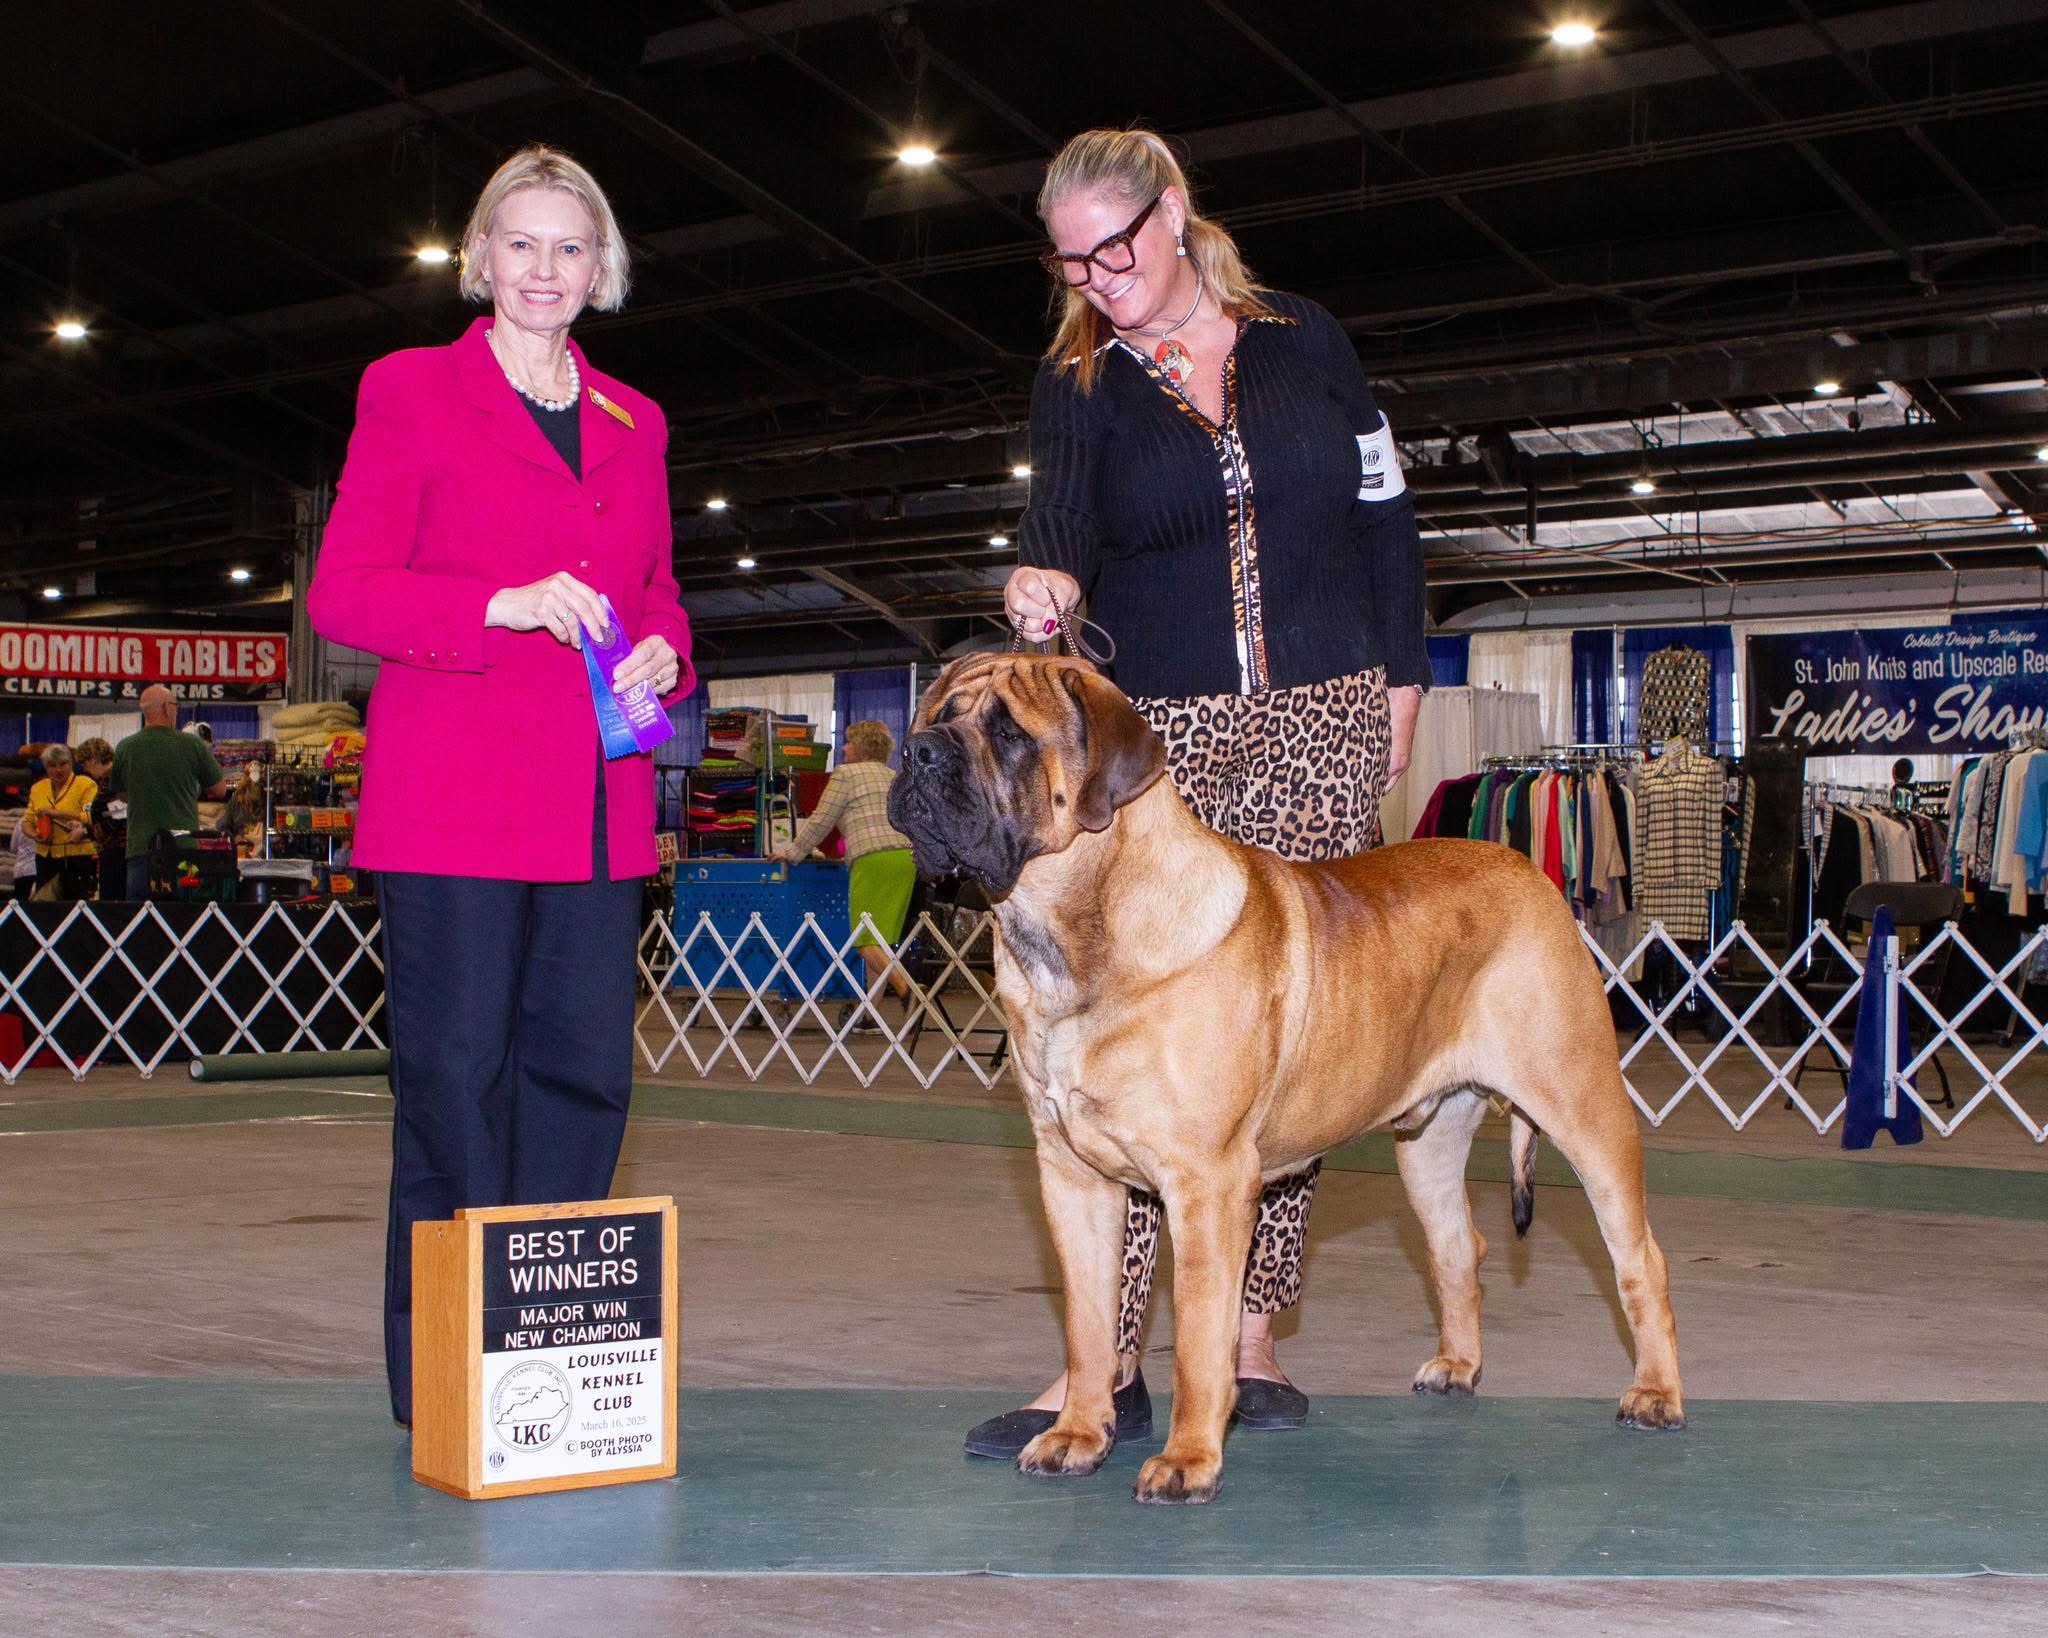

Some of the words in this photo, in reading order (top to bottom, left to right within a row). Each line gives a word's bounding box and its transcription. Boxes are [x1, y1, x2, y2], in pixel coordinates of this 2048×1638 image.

[1903, 632, 1944, 648] Cobalt
[1945, 631, 1985, 649] Design
[1987, 629, 2038, 647] Boutique
[0, 632, 143, 676] OOMING
[156, 638, 276, 678] TABLES
[1795, 658, 1818, 685] St.
[1825, 656, 1860, 683] John
[1867, 653, 1906, 681] Knits
[1913, 652, 1944, 680] and
[1951, 650, 2017, 683] Upscale
[5, 677, 111, 697] CLAMPS
[121, 682, 138, 698] &
[158, 683, 224, 699] RMS
[1762, 688, 1916, 746] Ladies'
[508, 1229, 585, 1261] BEST
[600, 1225, 636, 1254] OF
[509, 1258, 638, 1294] WINNERS
[520, 1304, 585, 1326] MAJOR
[593, 1300, 627, 1320] WIN
[505, 1329, 545, 1349] NEW
[552, 1321, 641, 1345] CHAMPION
[567, 1348, 658, 1369] LOUISVILLE
[581, 1372, 644, 1390] KENNEL
[593, 1395, 633, 1411] CLUB
[512, 1423, 551, 1446] LKC
[581, 1421, 608, 1431] March
[626, 1416, 647, 1426] 2025
[580, 1438, 615, 1450] BOOTH
[618, 1433, 652, 1446] PHOTO
[591, 1448, 602, 1458] BY
[606, 1444, 642, 1456] ALYSSIA
